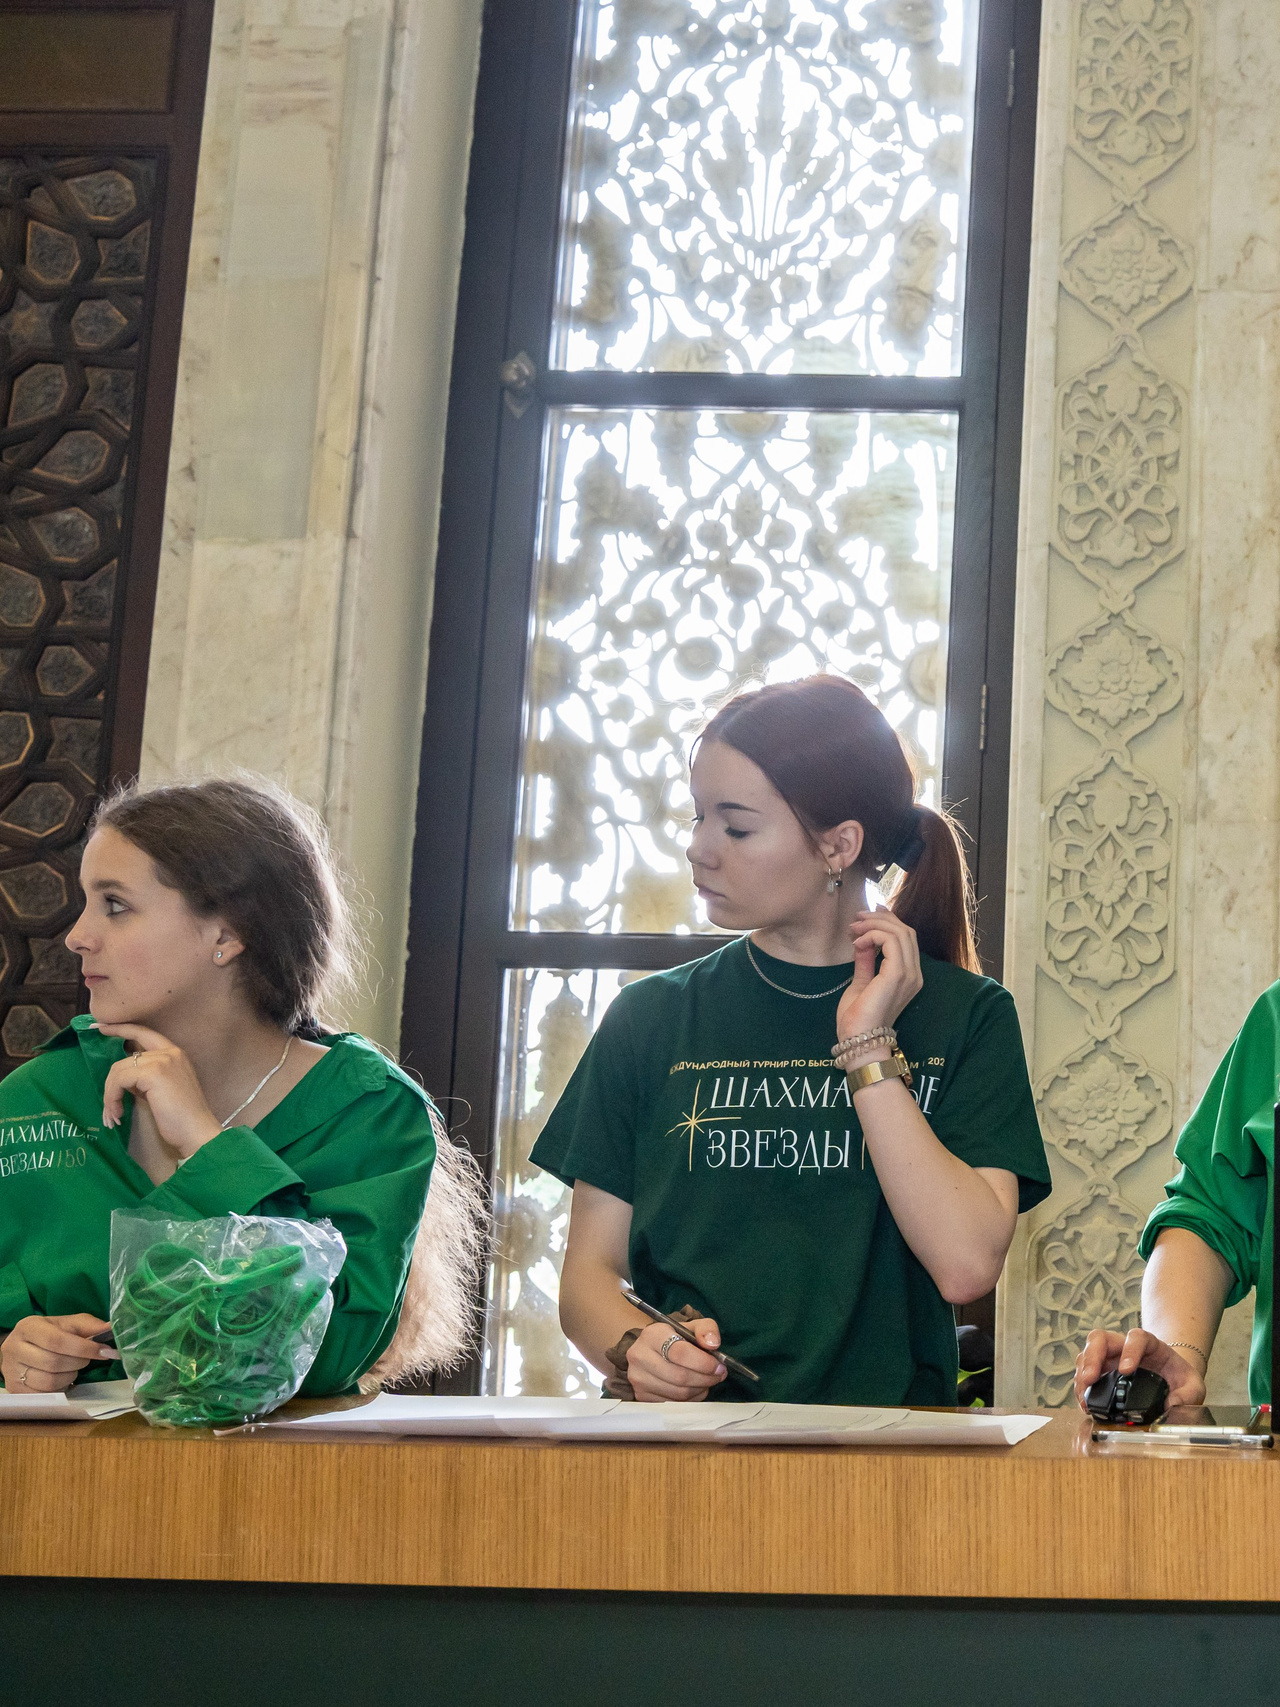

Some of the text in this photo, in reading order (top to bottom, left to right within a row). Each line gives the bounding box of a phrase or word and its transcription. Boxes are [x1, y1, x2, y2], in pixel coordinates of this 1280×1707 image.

[753, 1060, 789, 1068] ТУРНИР
[790, 1059, 806, 1067] ПО
[808, 1059, 836, 1067] БЫСТ
[927, 1056, 946, 1067] 202
[0, 1150, 55, 1178] ВЕЗДЫ
[706, 1127, 850, 1175] ЗВЕЗДЫ
